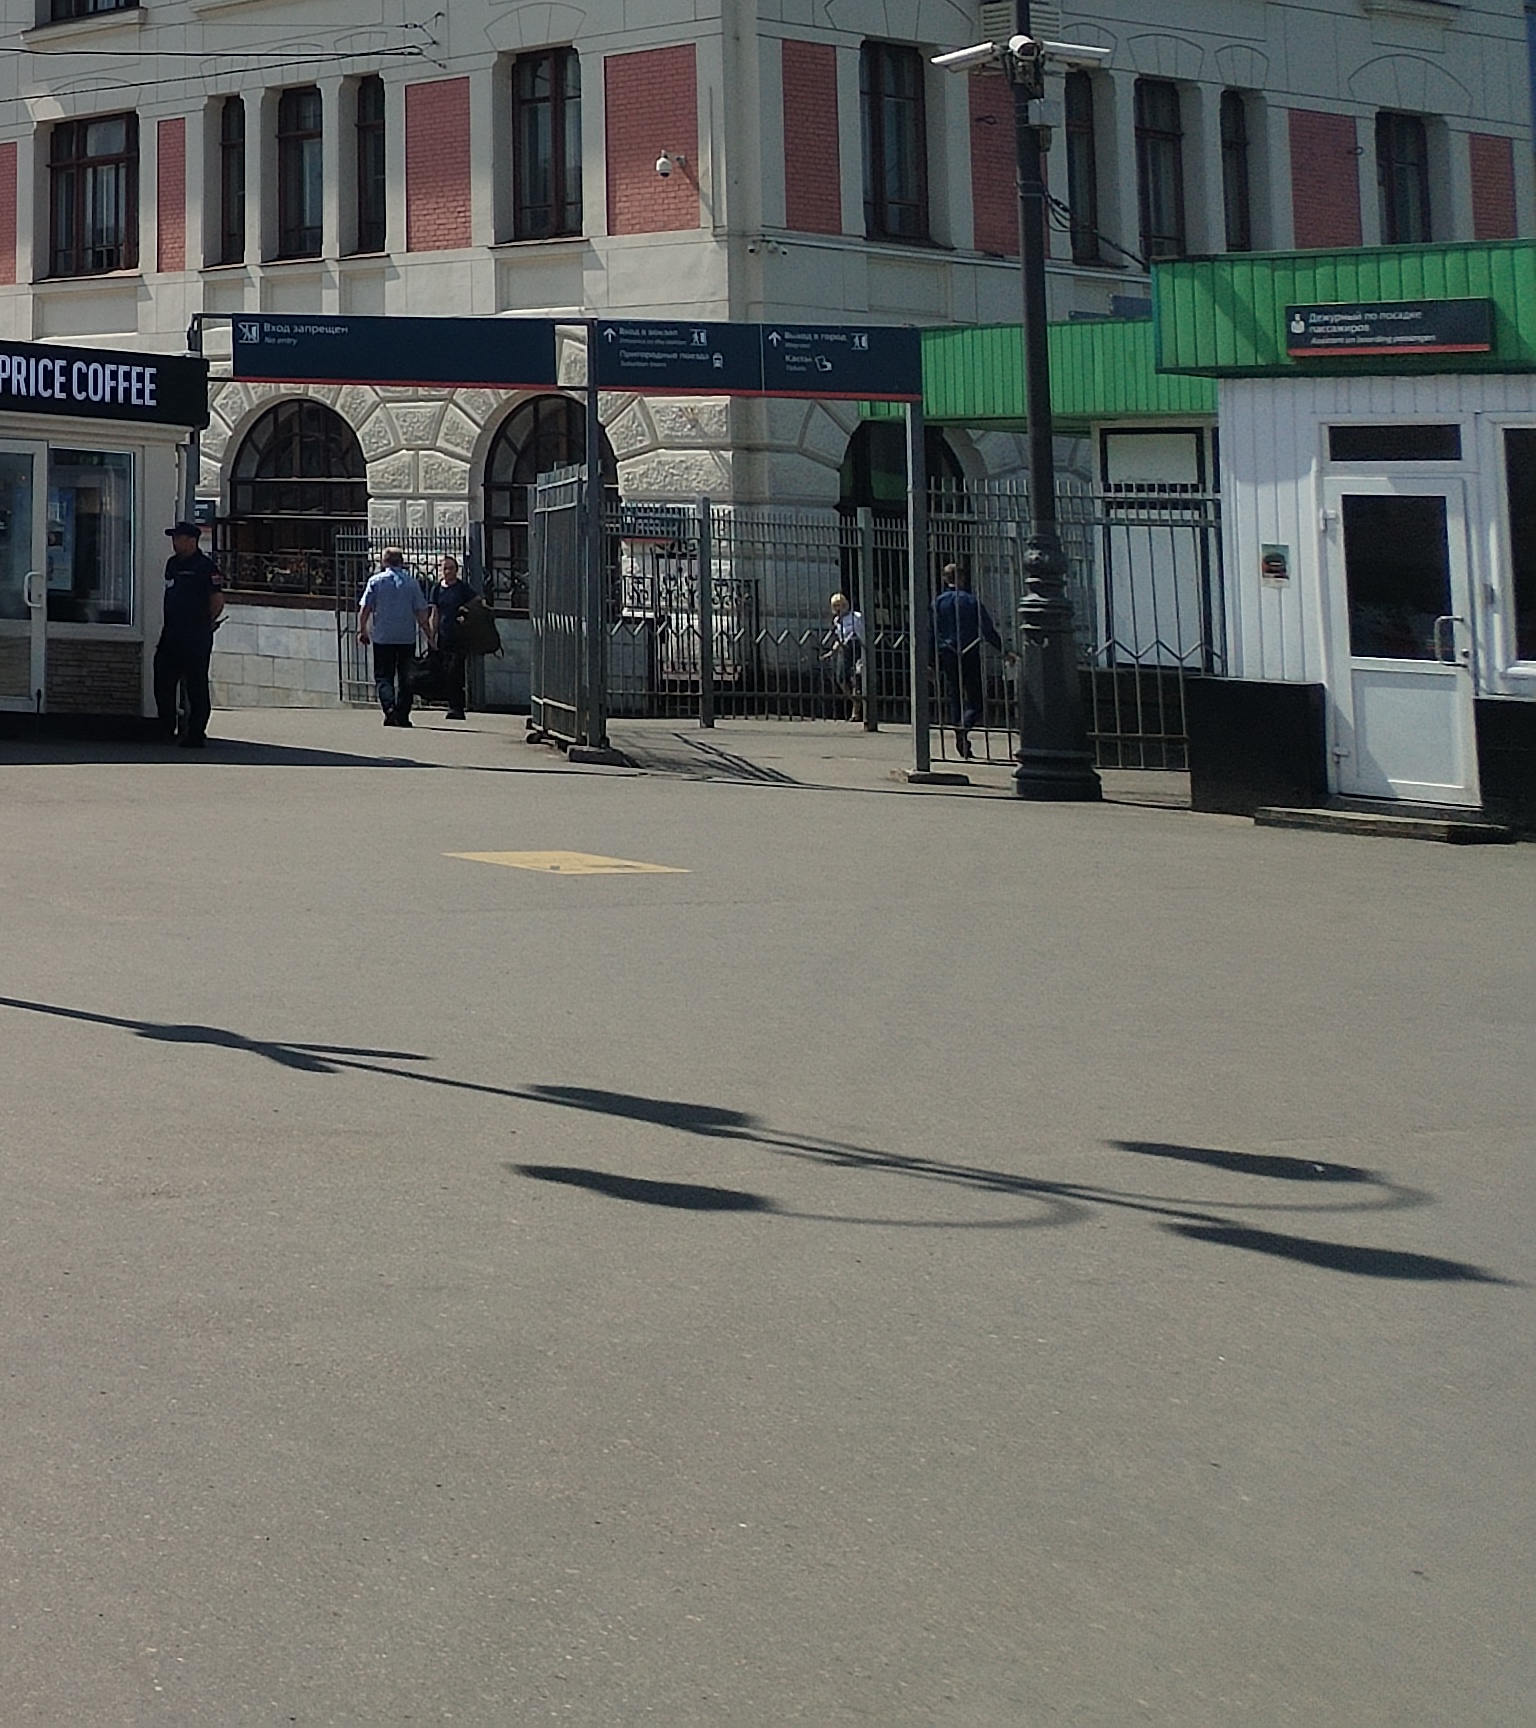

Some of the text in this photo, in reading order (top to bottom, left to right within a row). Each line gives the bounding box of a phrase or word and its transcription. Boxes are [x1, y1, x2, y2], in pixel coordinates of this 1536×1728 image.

[263, 322, 348, 335] Вход запрещен
[72, 361, 157, 406] COFFEE
